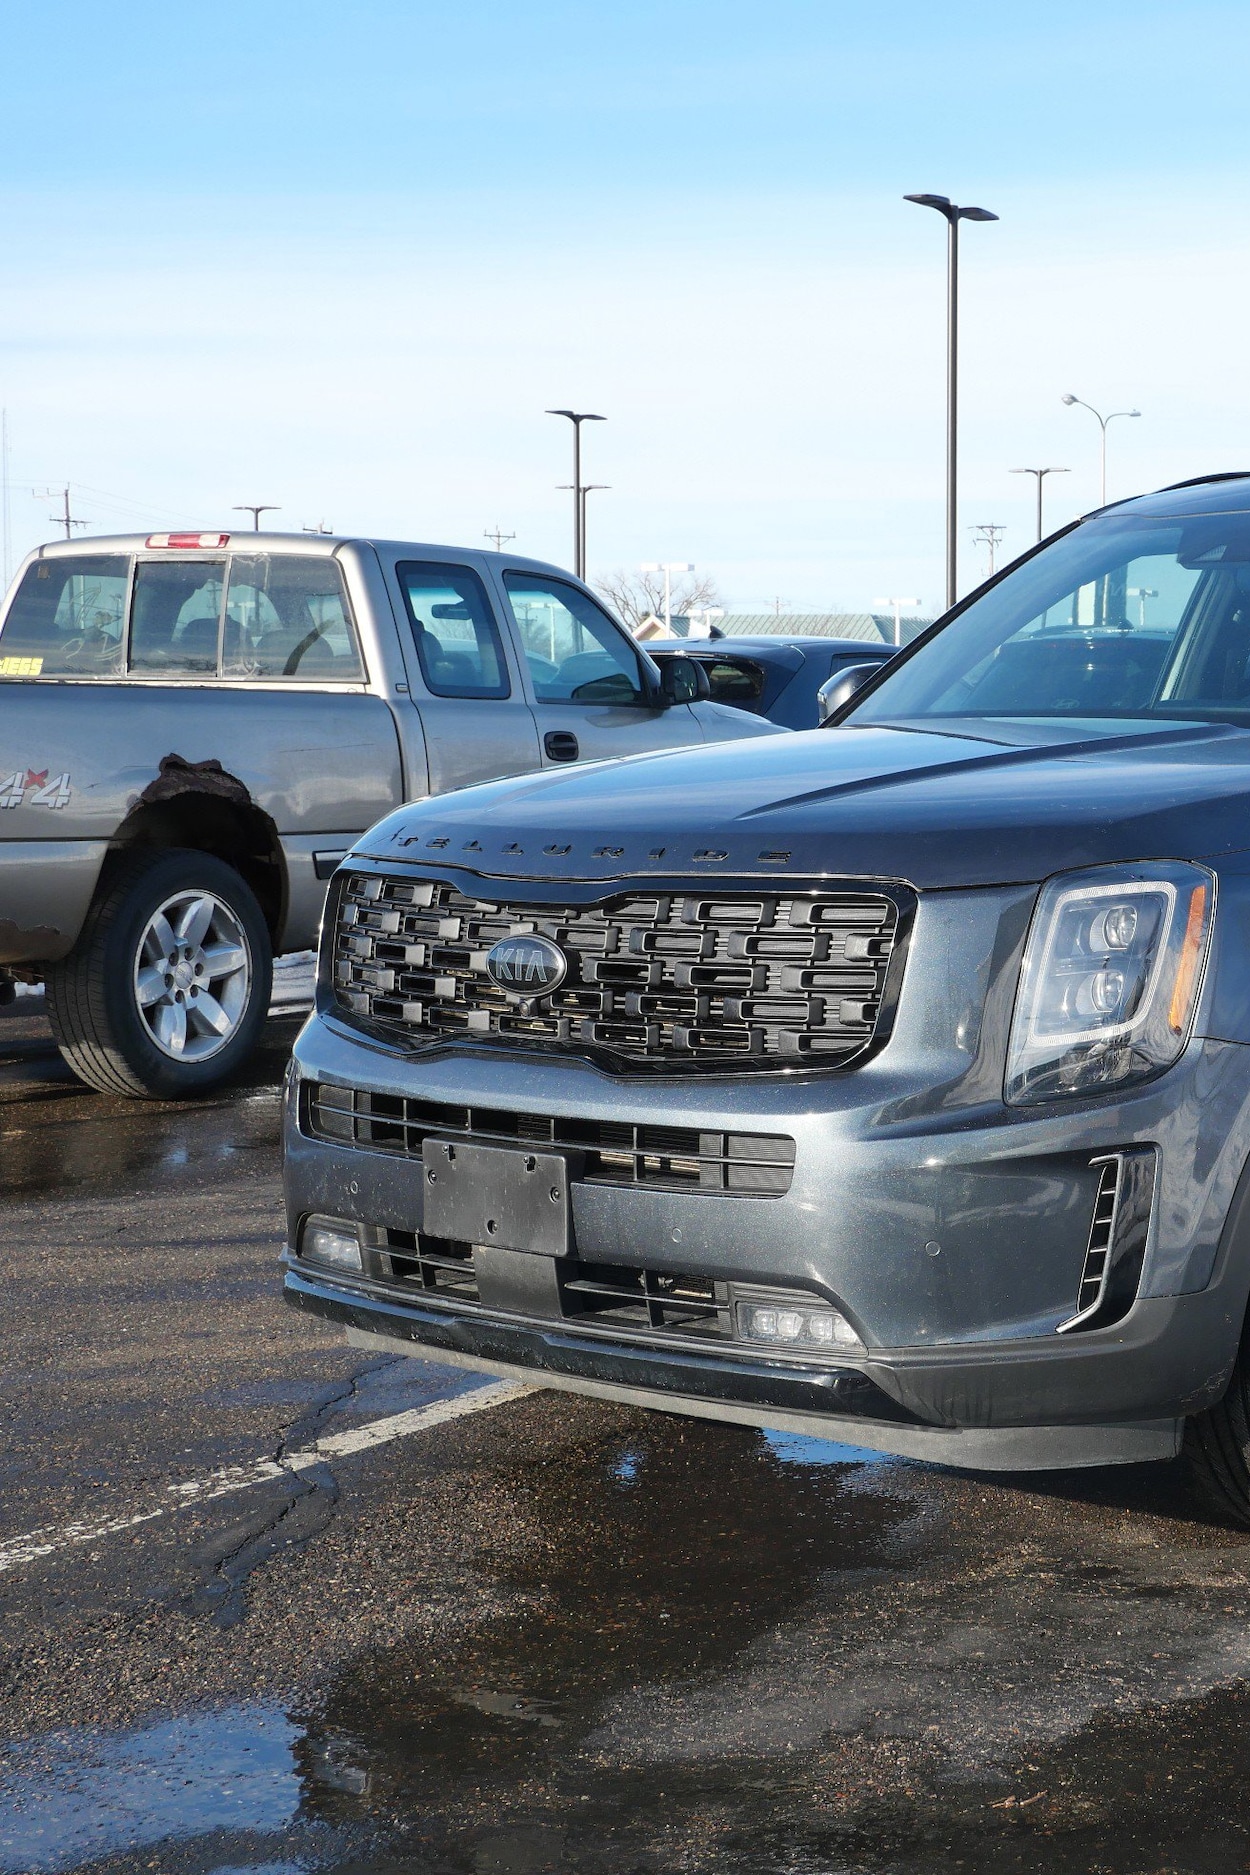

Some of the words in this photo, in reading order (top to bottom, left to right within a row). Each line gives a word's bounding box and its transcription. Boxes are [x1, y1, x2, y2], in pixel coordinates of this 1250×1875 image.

[0, 656, 44, 676] JEGS
[398, 835, 792, 863] TELLURIDE
[495, 947, 548, 983] KIA
